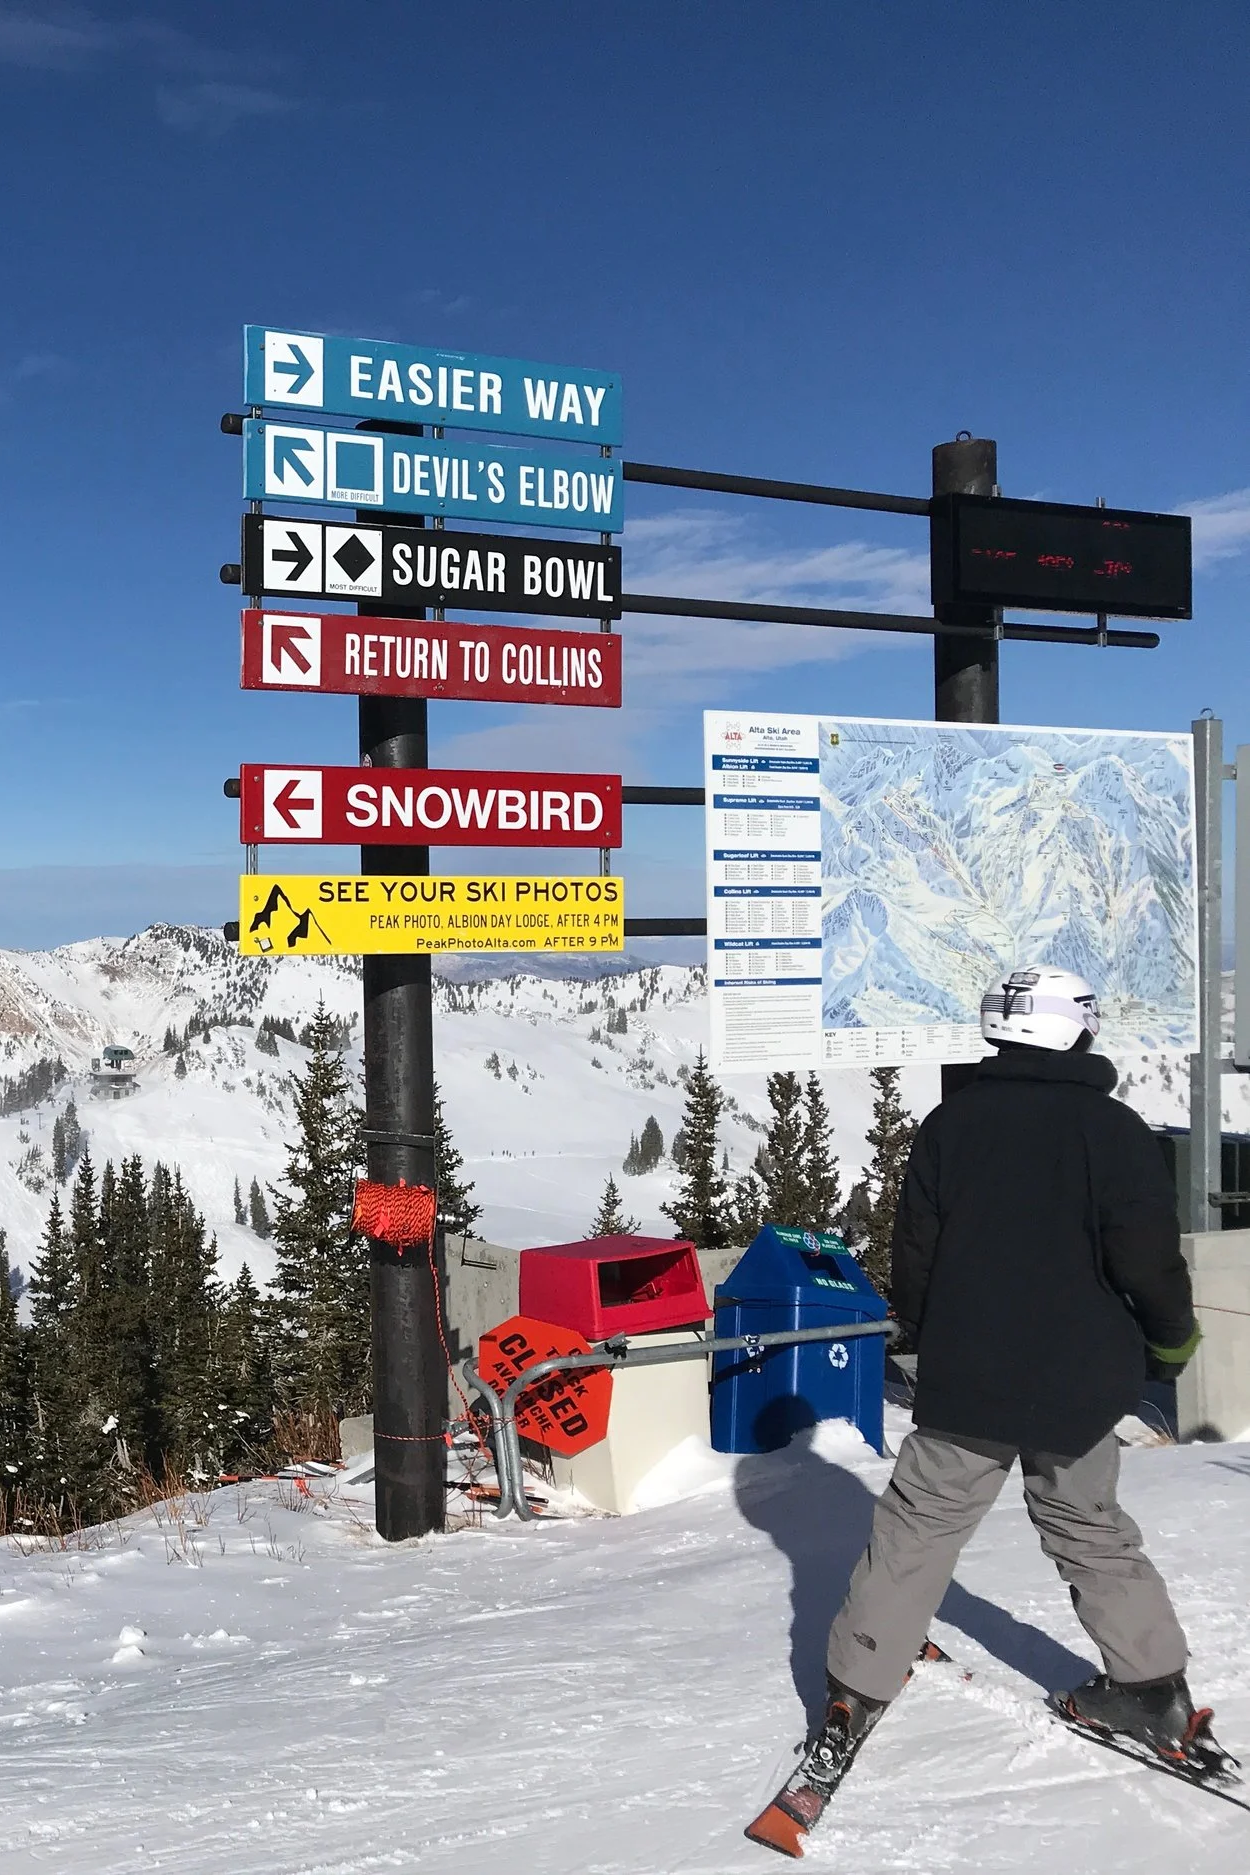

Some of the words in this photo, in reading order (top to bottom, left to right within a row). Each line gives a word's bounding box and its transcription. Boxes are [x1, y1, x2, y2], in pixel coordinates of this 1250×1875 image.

[350, 355, 502, 415] EASIER
[524, 377, 606, 427] WAY
[331, 490, 348, 500] MORE
[350, 492, 379, 502] DIFFICULT
[392, 452, 504, 503] DEVIL'S
[519, 465, 614, 515] ELBOW
[392, 542, 505, 593] SUGAR
[523, 555, 613, 602] BOWL
[329, 583, 346, 591] MOST
[349, 584, 378, 593] DIFFICULT
[345, 633, 447, 681] RETURN
[459, 640, 489, 682] TO
[502, 643, 603, 689] COLLINS
[724, 732, 742, 741] ALTA
[749, 726, 765, 734] Alta
[767, 727, 780, 735] Ski
[782, 728, 801, 736] Area
[346, 783, 603, 832] SNOWBIRD
[319, 881, 370, 902] SEE
[380, 881, 456, 902] YOUR
[467, 882, 505, 902] SKI
[516, 882, 618, 902] PHOTOS
[370, 914, 400, 929] PEAK
[447, 914, 487, 928] ALBION
[491, 914, 512, 928] DAY
[557, 914, 590, 927] AFTER
[593, 914, 600, 927] 4
[604, 914, 619, 927] PM
[416, 938, 536, 949] PeakPhotoAlta.com
[544, 937, 585, 947] AFTER
[589, 937, 597, 947] 9
[601, 936, 619, 947] PM
[815, 1277, 828, 1287] NO
[828, 1279, 855, 1291] GLASS
[546, 1346, 589, 1398] TACK
[568, 1347, 597, 1376] CT
[488, 1379, 531, 1429] DAER
[492, 1361, 554, 1433] AVAANCHE
